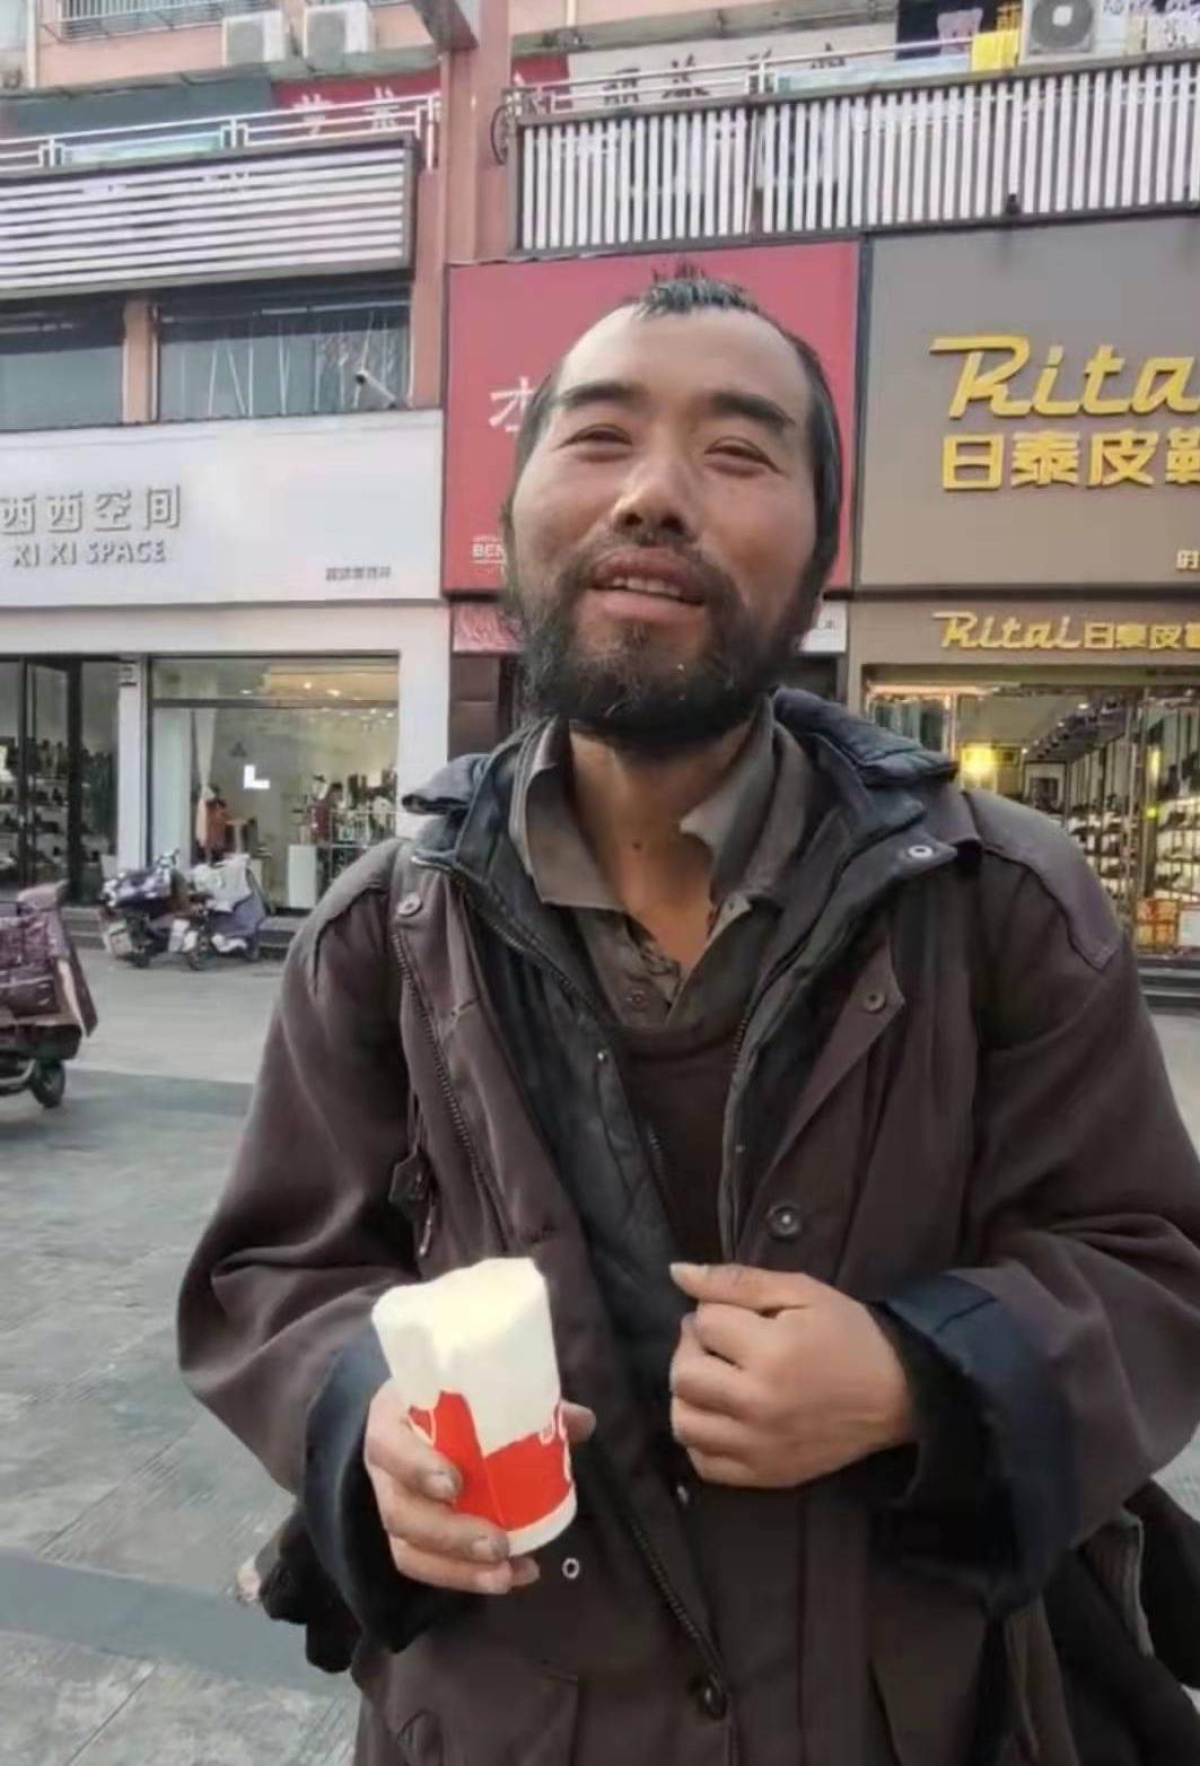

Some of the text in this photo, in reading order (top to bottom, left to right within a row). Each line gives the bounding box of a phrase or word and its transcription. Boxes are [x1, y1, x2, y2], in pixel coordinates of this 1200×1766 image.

[0, 484, 180, 535] 西西空间
[14, 540, 166, 567] XI XI SPACE
